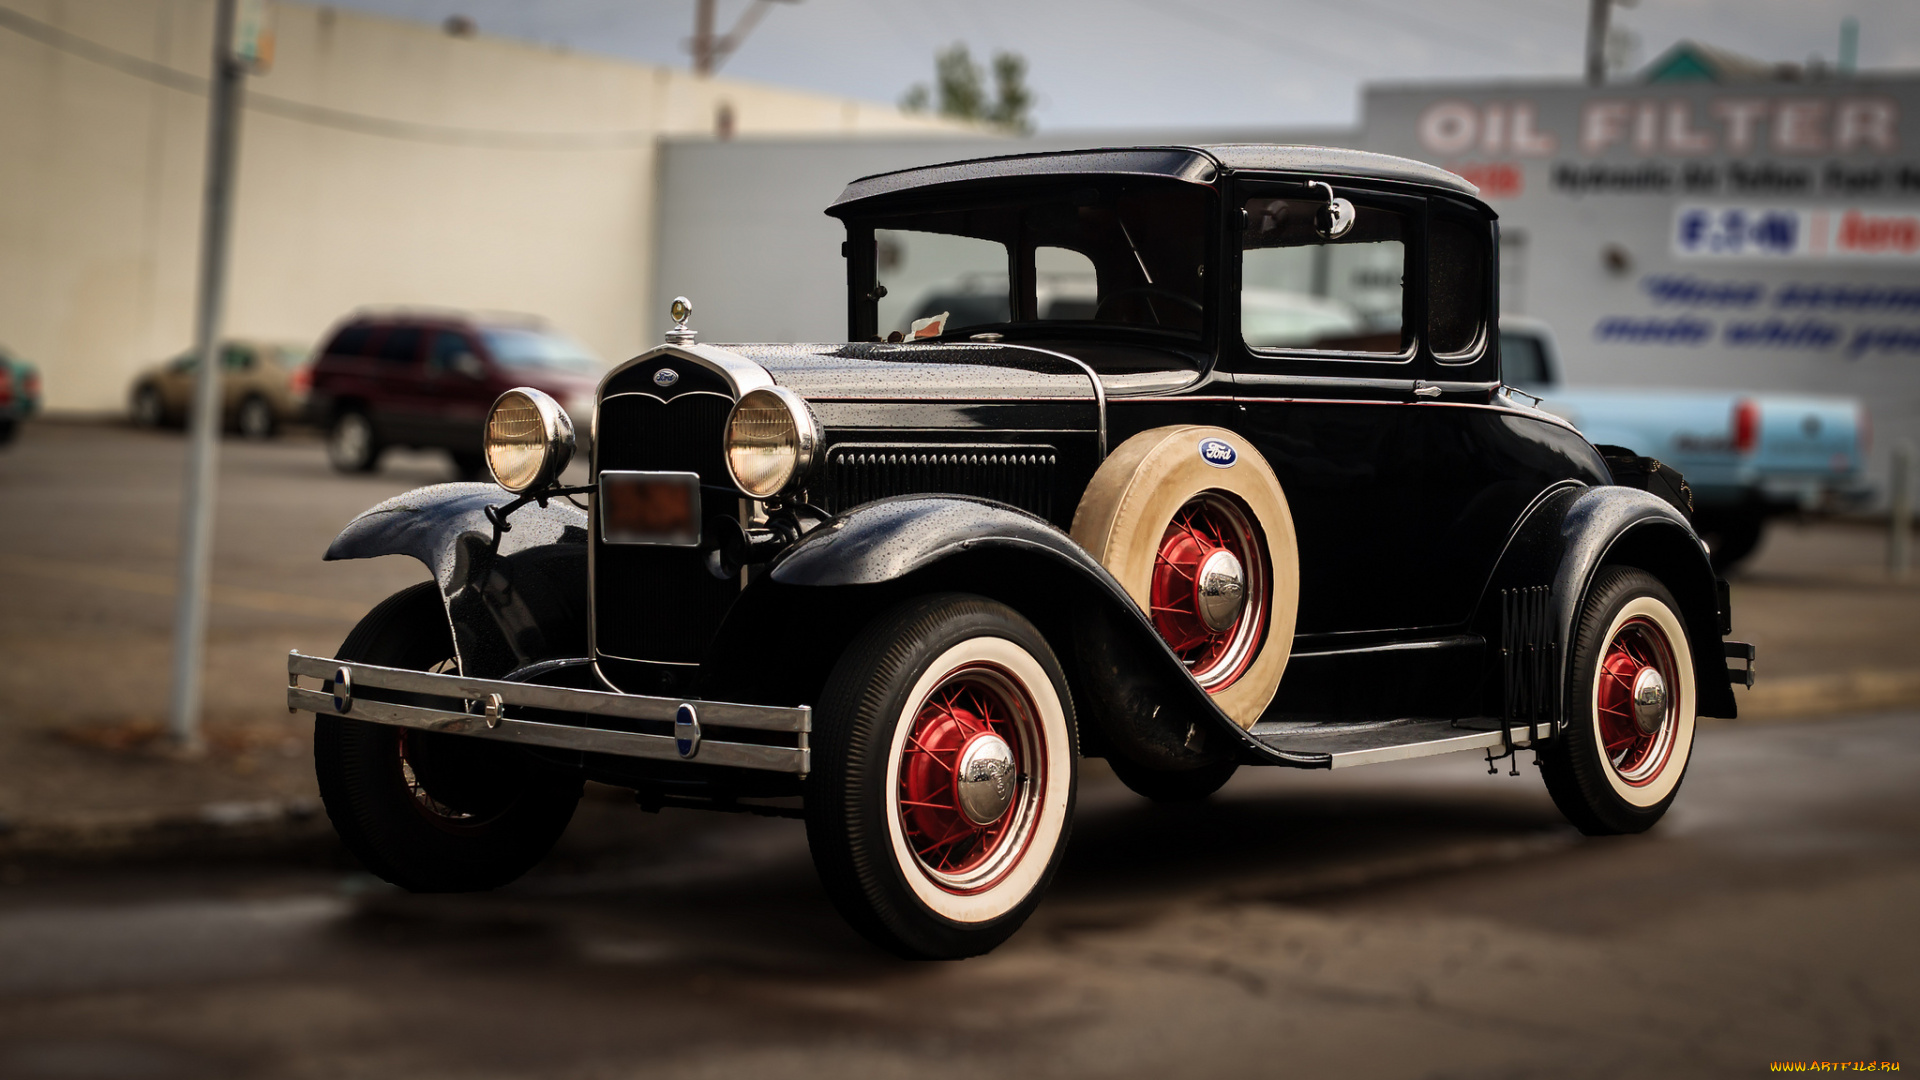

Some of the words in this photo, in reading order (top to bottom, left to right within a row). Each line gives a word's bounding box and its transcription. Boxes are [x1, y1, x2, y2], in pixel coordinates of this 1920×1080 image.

[1418, 101, 1556, 154] OIL
[1582, 99, 1898, 154] FILTER
[1206, 442, 1231, 460] Ford
